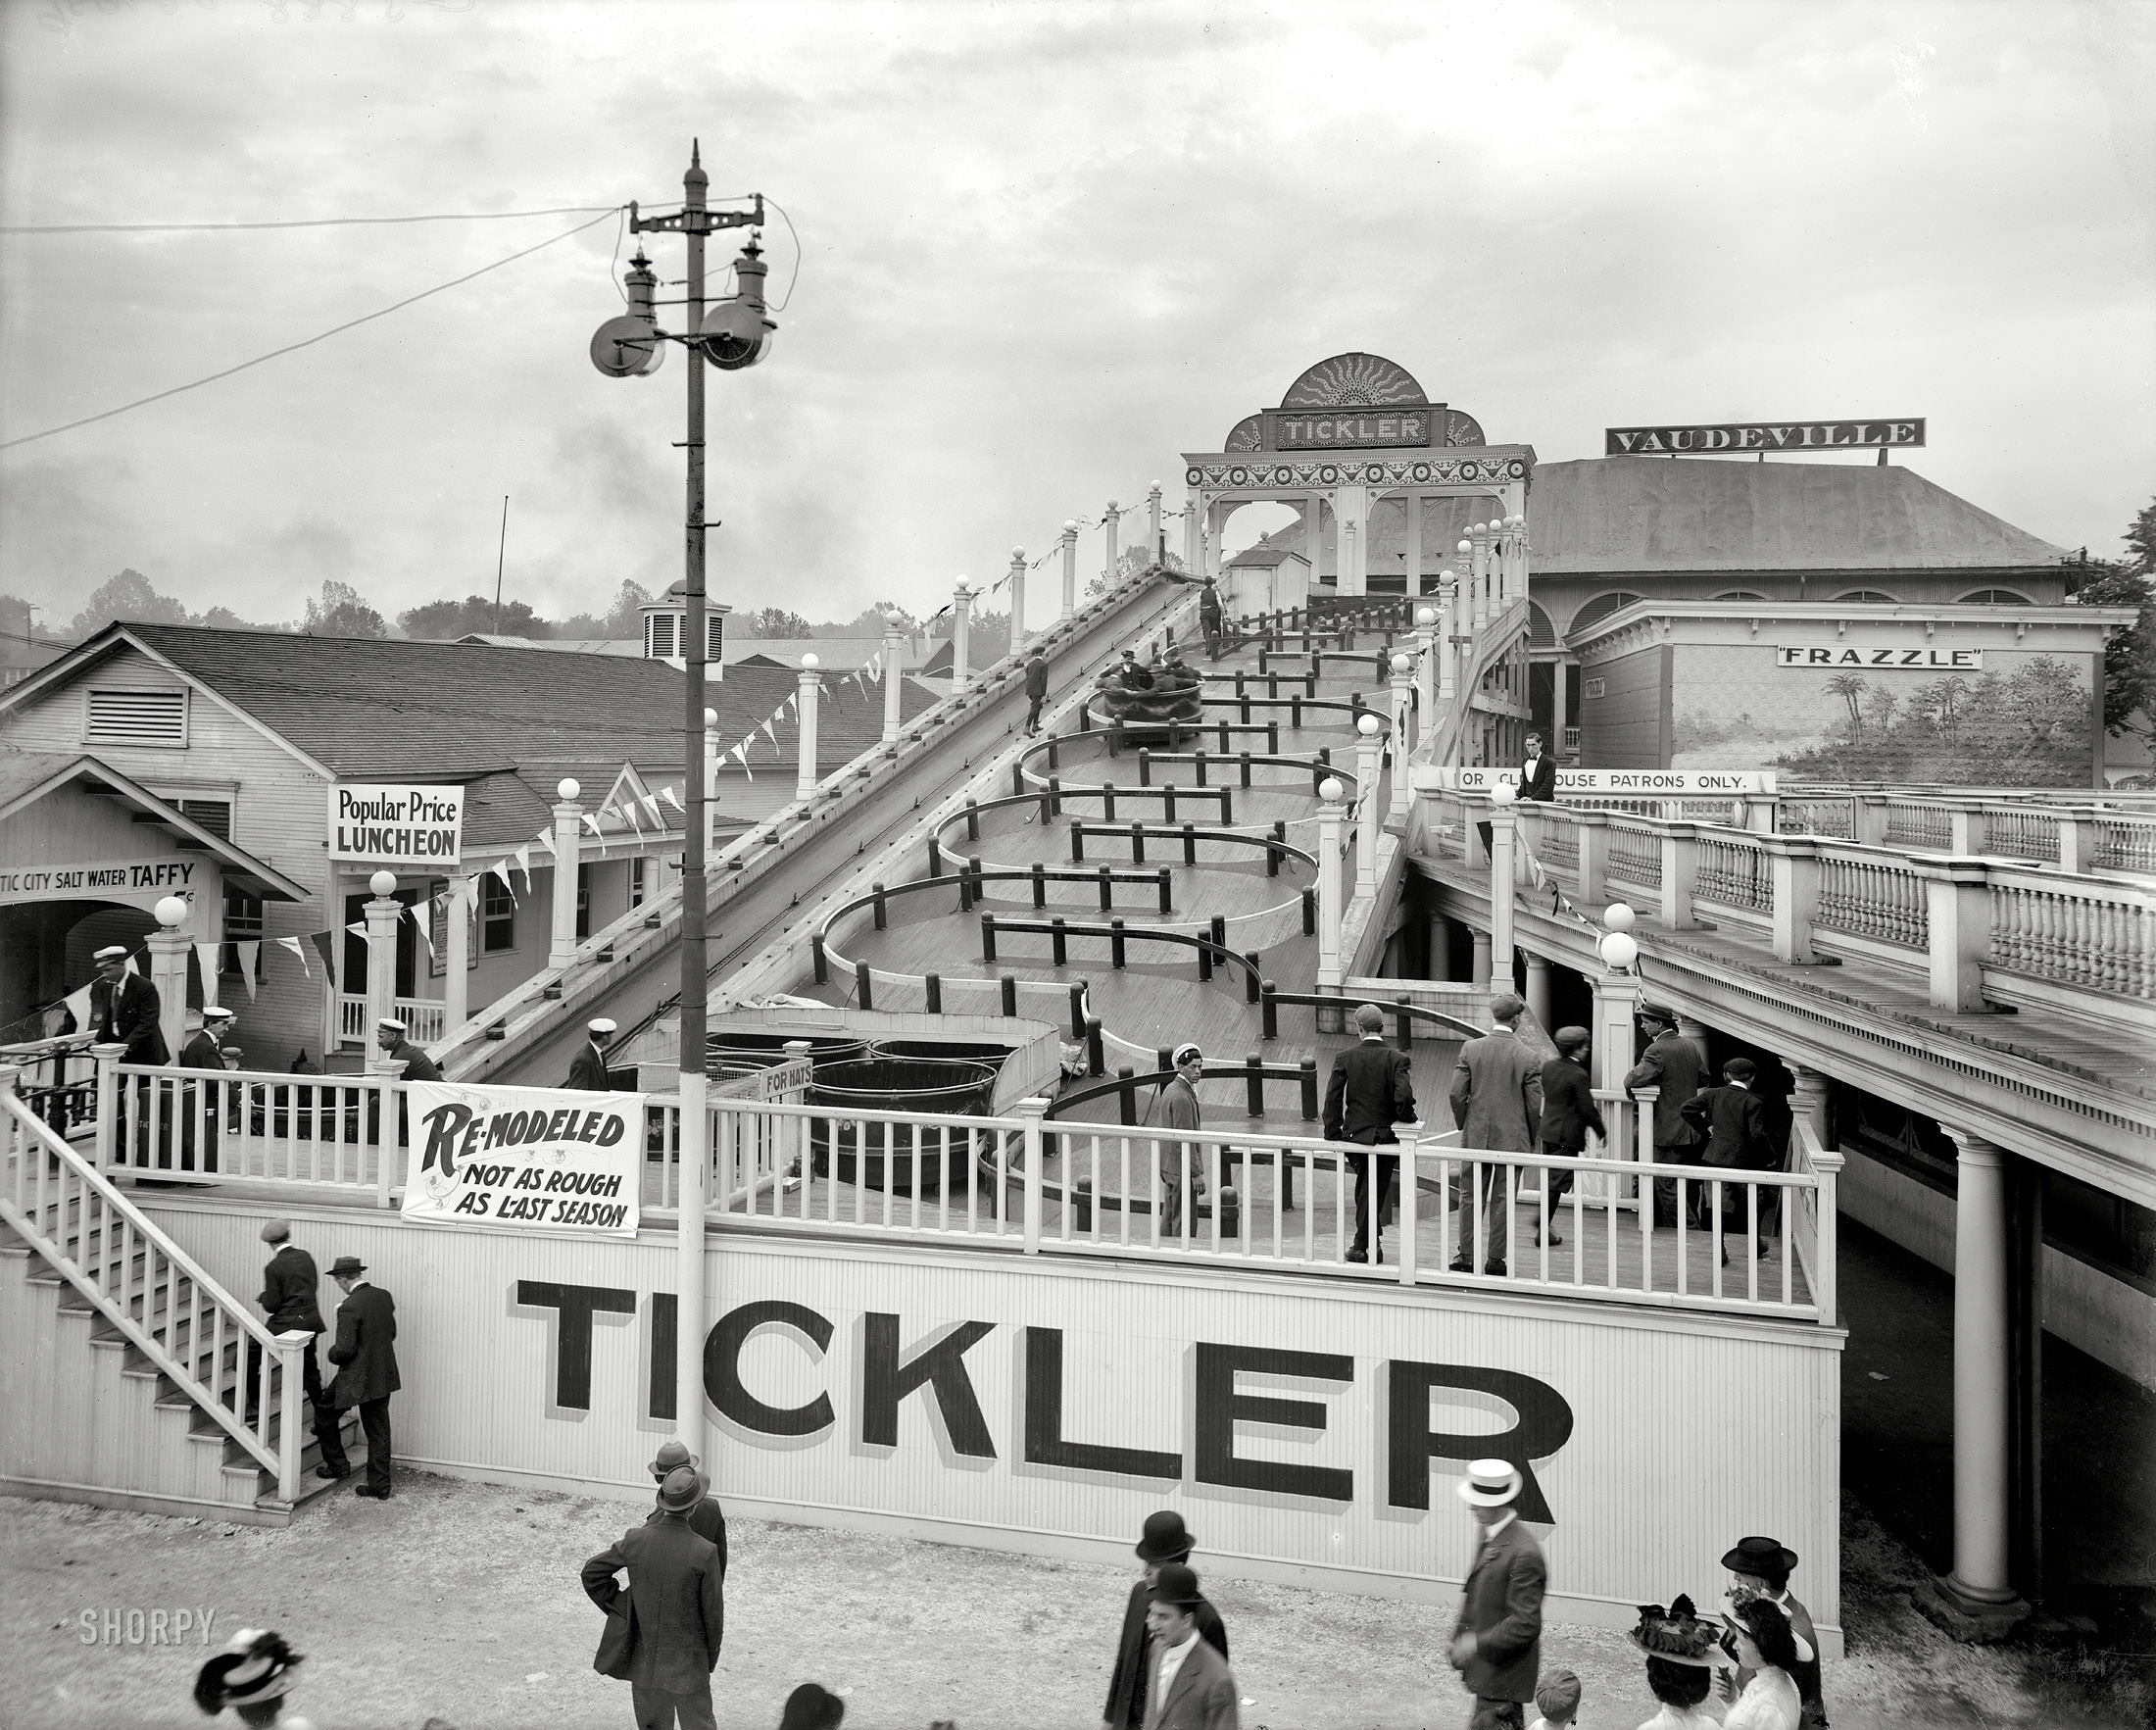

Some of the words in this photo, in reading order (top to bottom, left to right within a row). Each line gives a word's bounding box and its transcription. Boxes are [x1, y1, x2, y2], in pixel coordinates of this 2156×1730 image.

[1285, 419, 1420, 440] TICKLER
[1615, 422, 1916, 453] VAUDEVILLE
[1499, 773, 1597, 787] CLOUSE
[1610, 774, 1685, 788] PATRONS
[1697, 775, 1747, 788] ONLY.
[339, 789, 406, 825] Popular
[410, 791, 457, 822] Price
[337, 825, 456, 856] LUNCHEON
[24, 872, 52, 890] CITY
[55, 871, 84, 889] SALT
[87, 868, 126, 887] WATER
[129, 863, 195, 887] TAFFY
[766, 1072, 787, 1094] FOR
[789, 1064, 812, 1087] HATS
[462, 1163, 515, 1188] NOT
[514, 1167, 545, 1191] AS
[544, 1170, 623, 1198] ROUGH
[454, 1191, 492, 1216] AS
[551, 1200, 629, 1228] SEASON
[516, 1279, 1574, 1525] TICKLER
